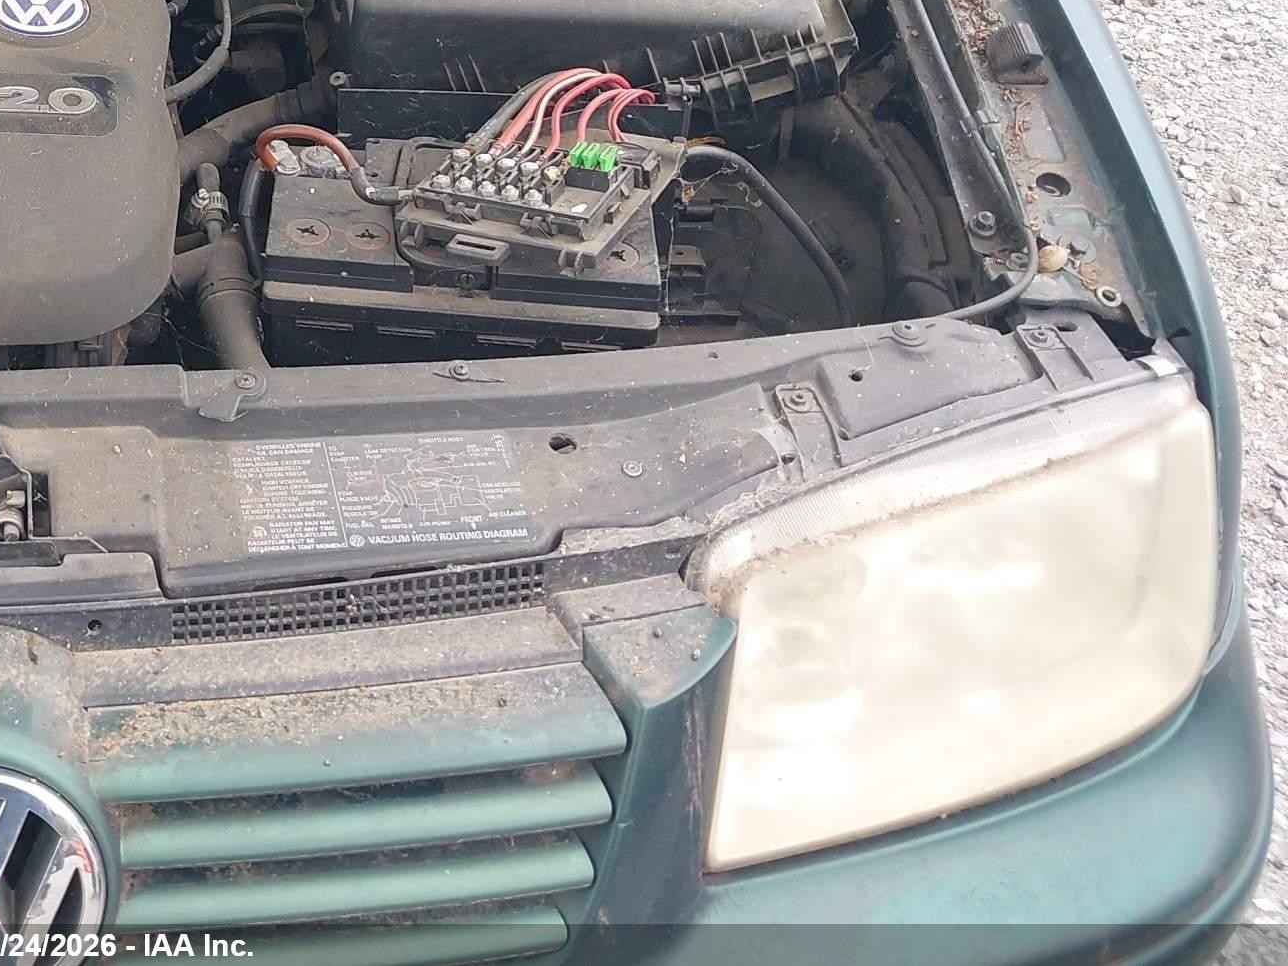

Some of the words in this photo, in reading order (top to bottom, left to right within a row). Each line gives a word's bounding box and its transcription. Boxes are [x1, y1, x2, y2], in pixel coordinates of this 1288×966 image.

[460, 514, 483, 523] FRONT
[367, 534, 411, 545] VACUUM
[412, 532, 438, 542] HOSE
[439, 530, 483, 542] ROUTING
[483, 528, 529, 540] DIAGRAM
